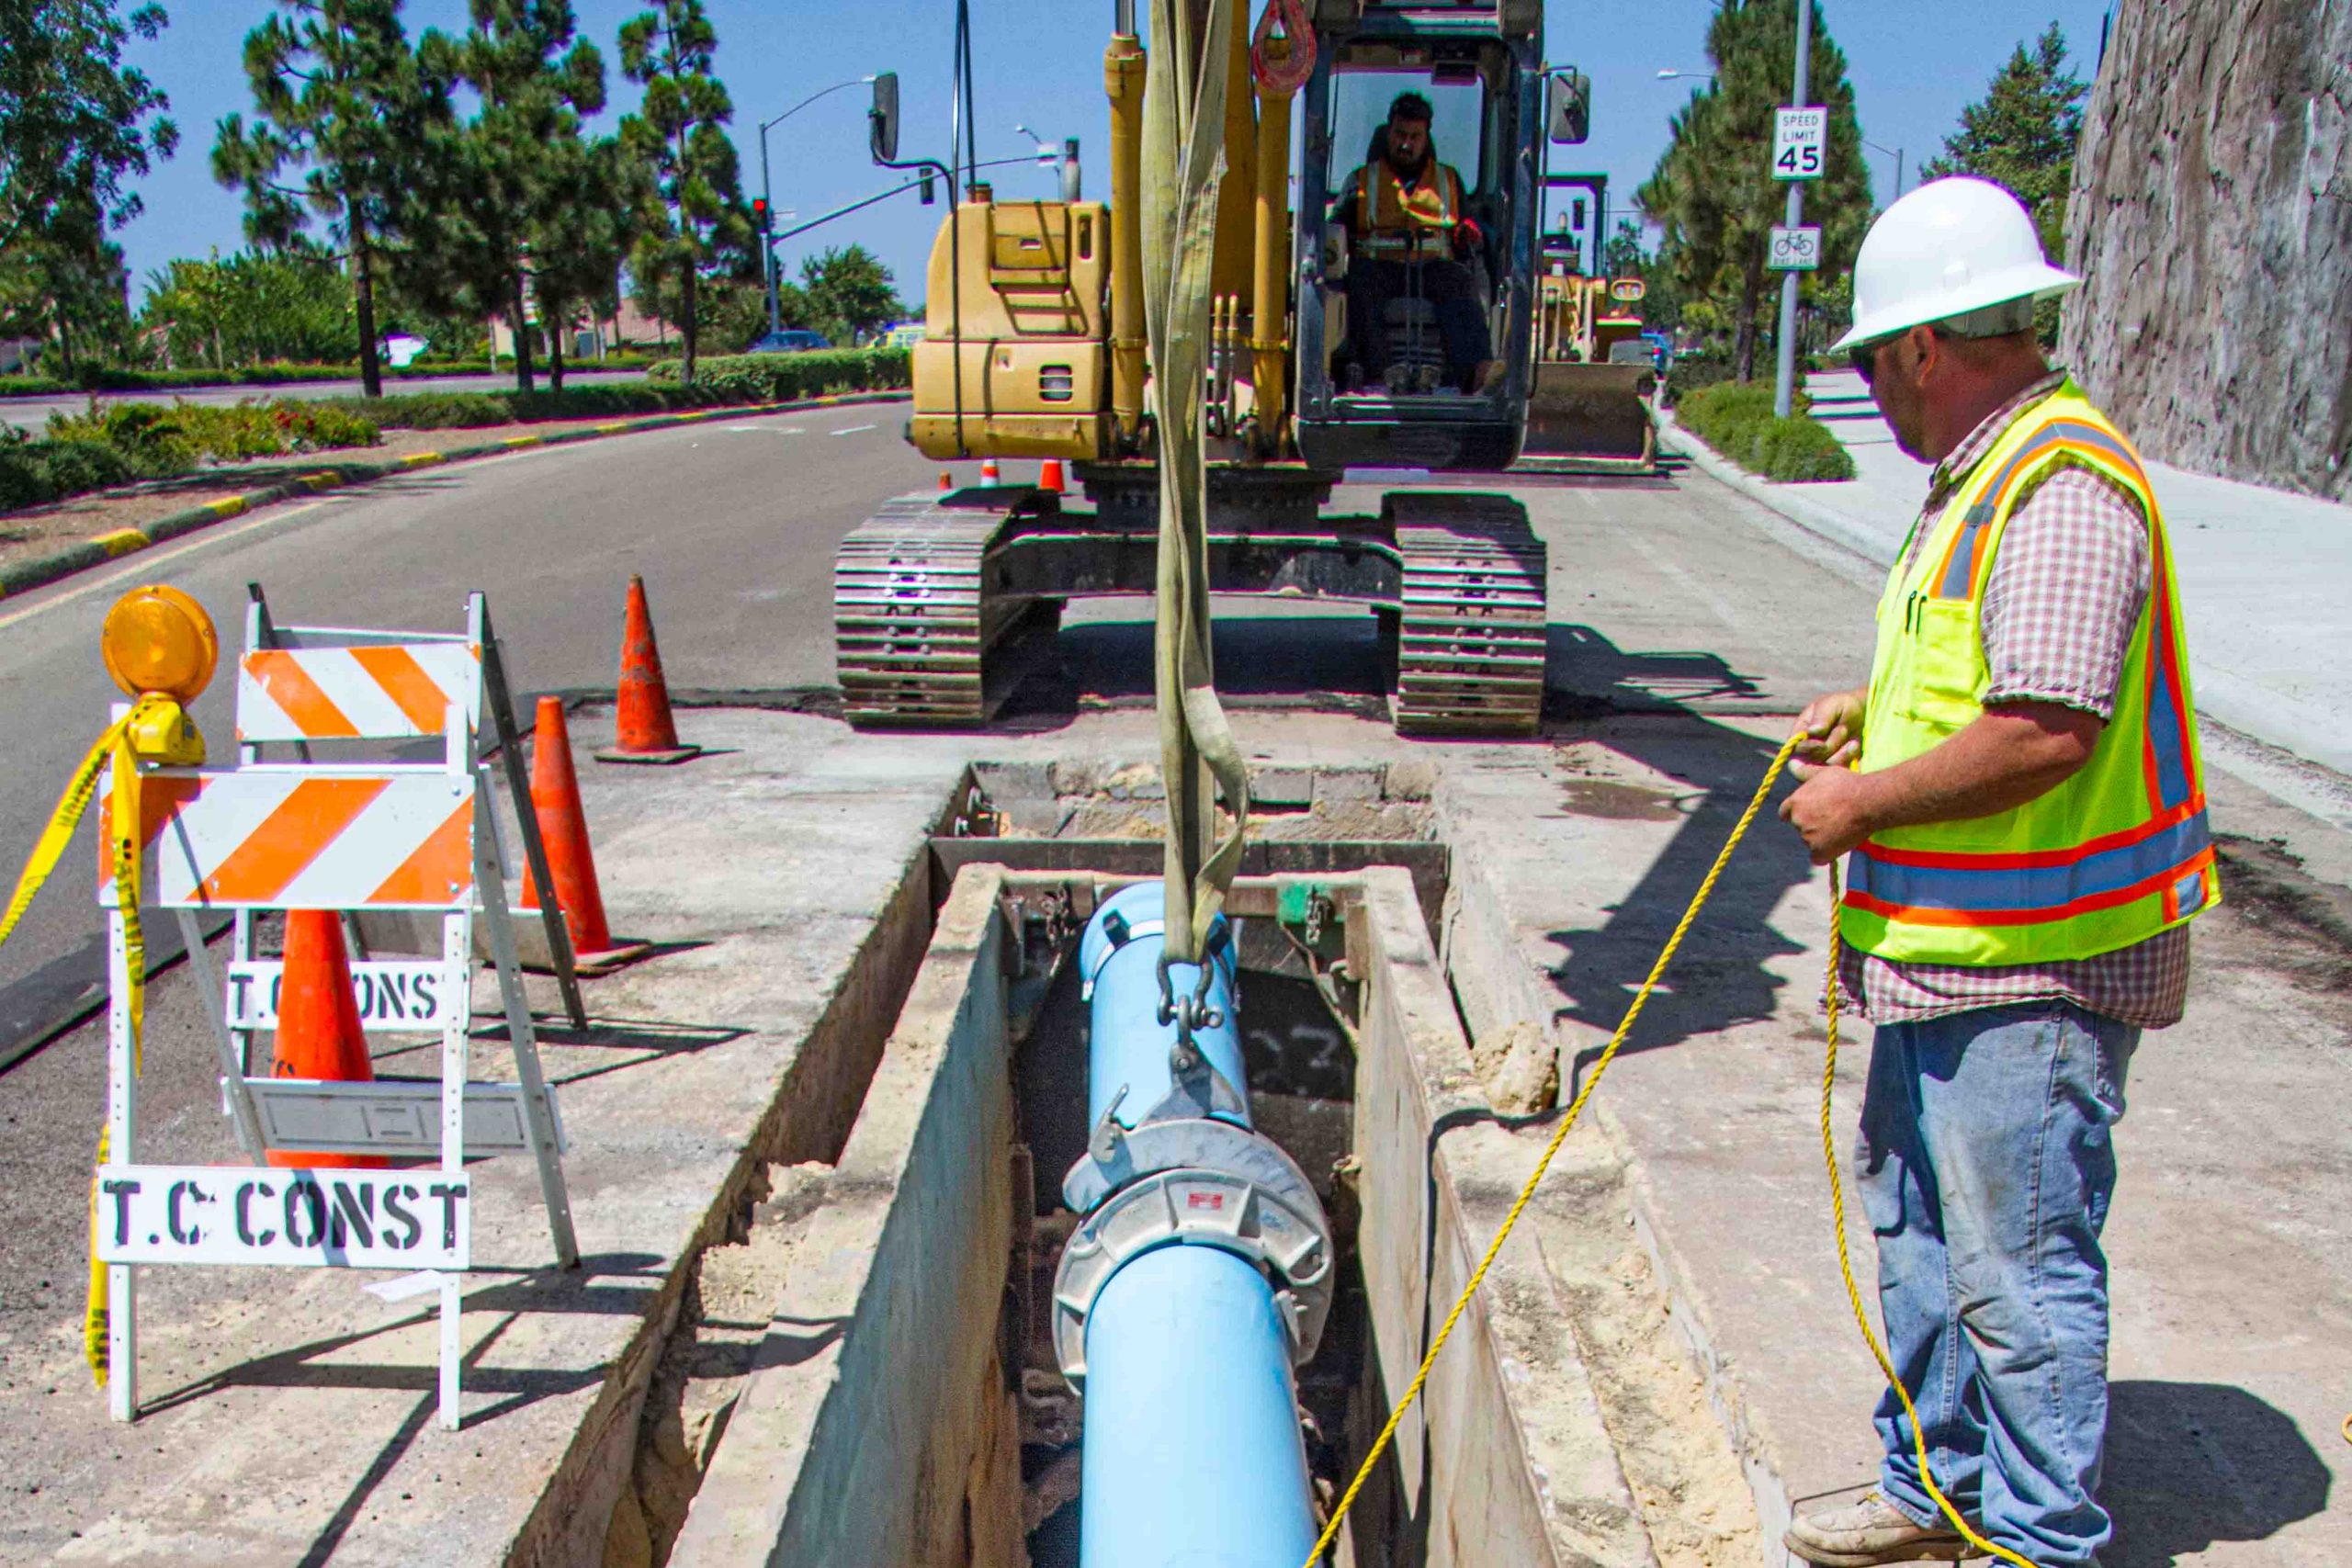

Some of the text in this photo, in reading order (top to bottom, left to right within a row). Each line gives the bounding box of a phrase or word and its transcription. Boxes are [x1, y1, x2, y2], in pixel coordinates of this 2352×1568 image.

[1782, 116, 1818, 127] SPEED
[1782, 130, 1815, 142] LIMIT
[1778, 145, 1818, 172] 45
[235, 1181, 468, 1250] CONST
